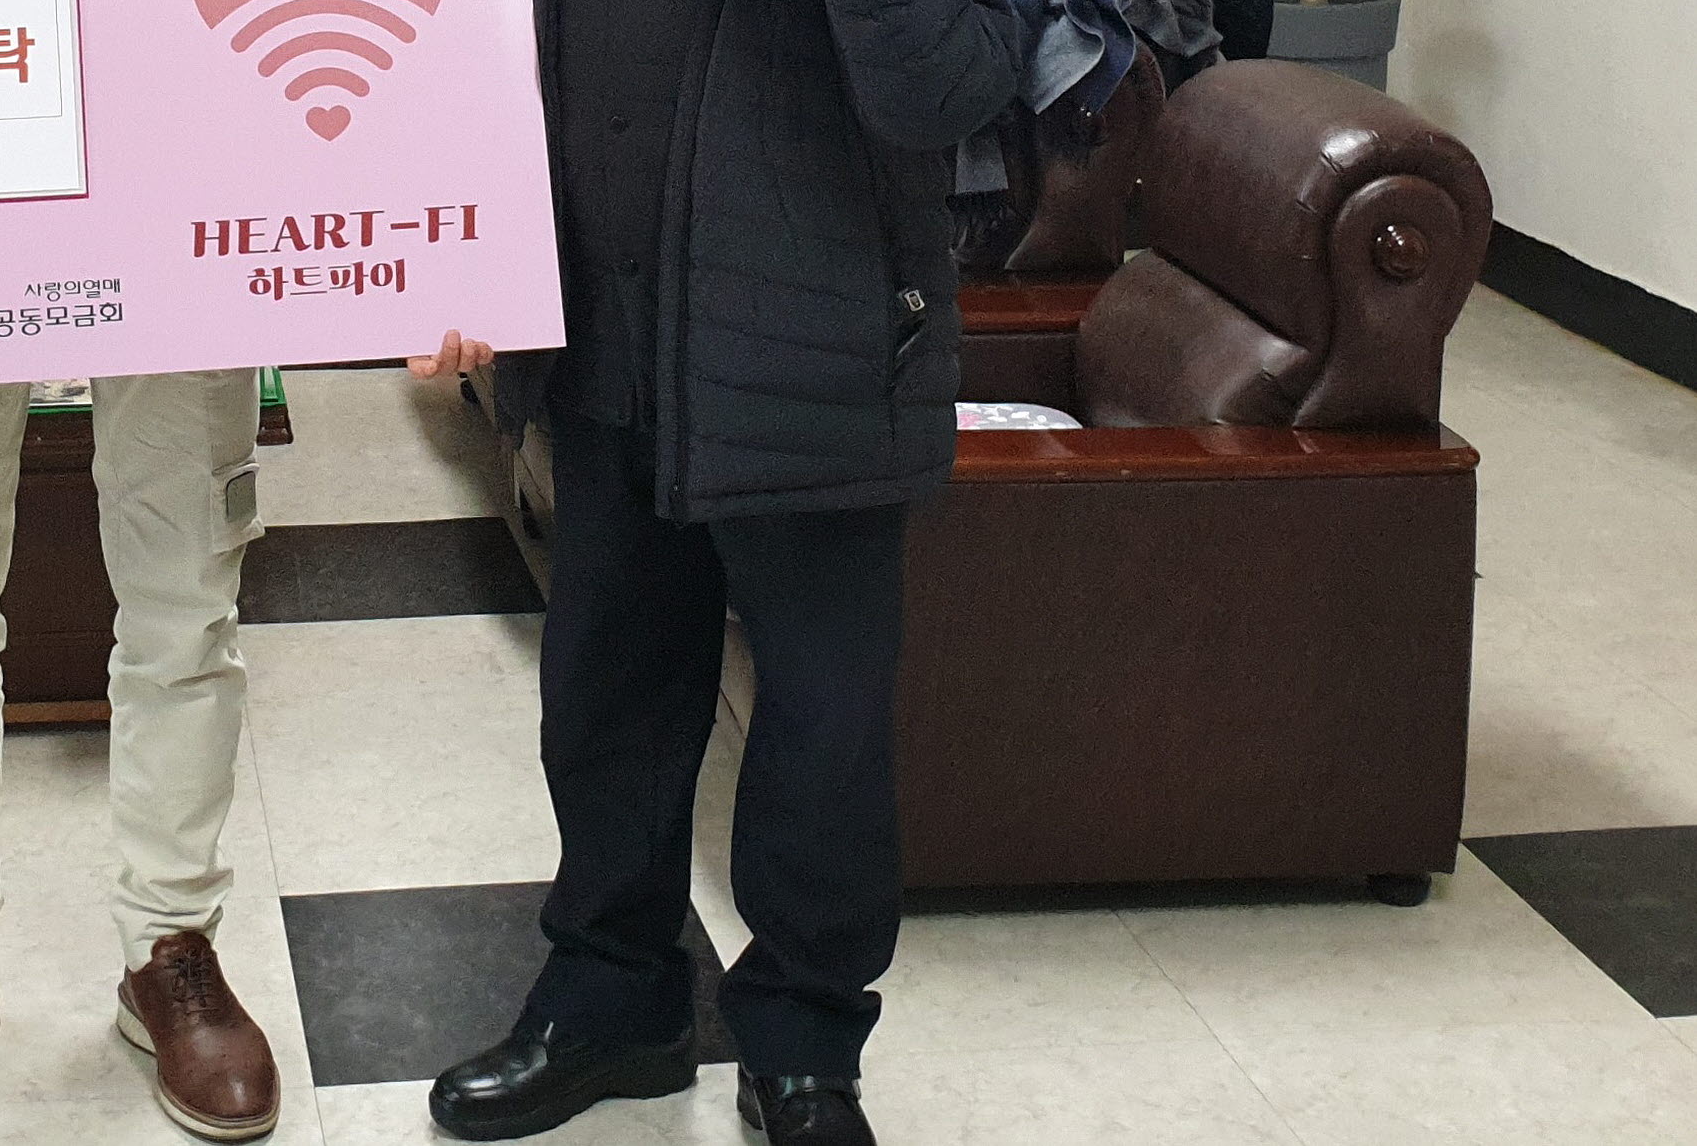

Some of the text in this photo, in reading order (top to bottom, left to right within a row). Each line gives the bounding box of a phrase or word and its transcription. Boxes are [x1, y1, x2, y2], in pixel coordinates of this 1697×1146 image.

[191, 204, 480, 258] HEART-FI
[23, 277, 122, 302] 사랑의열매
[247, 258, 406, 301] 하트파이
